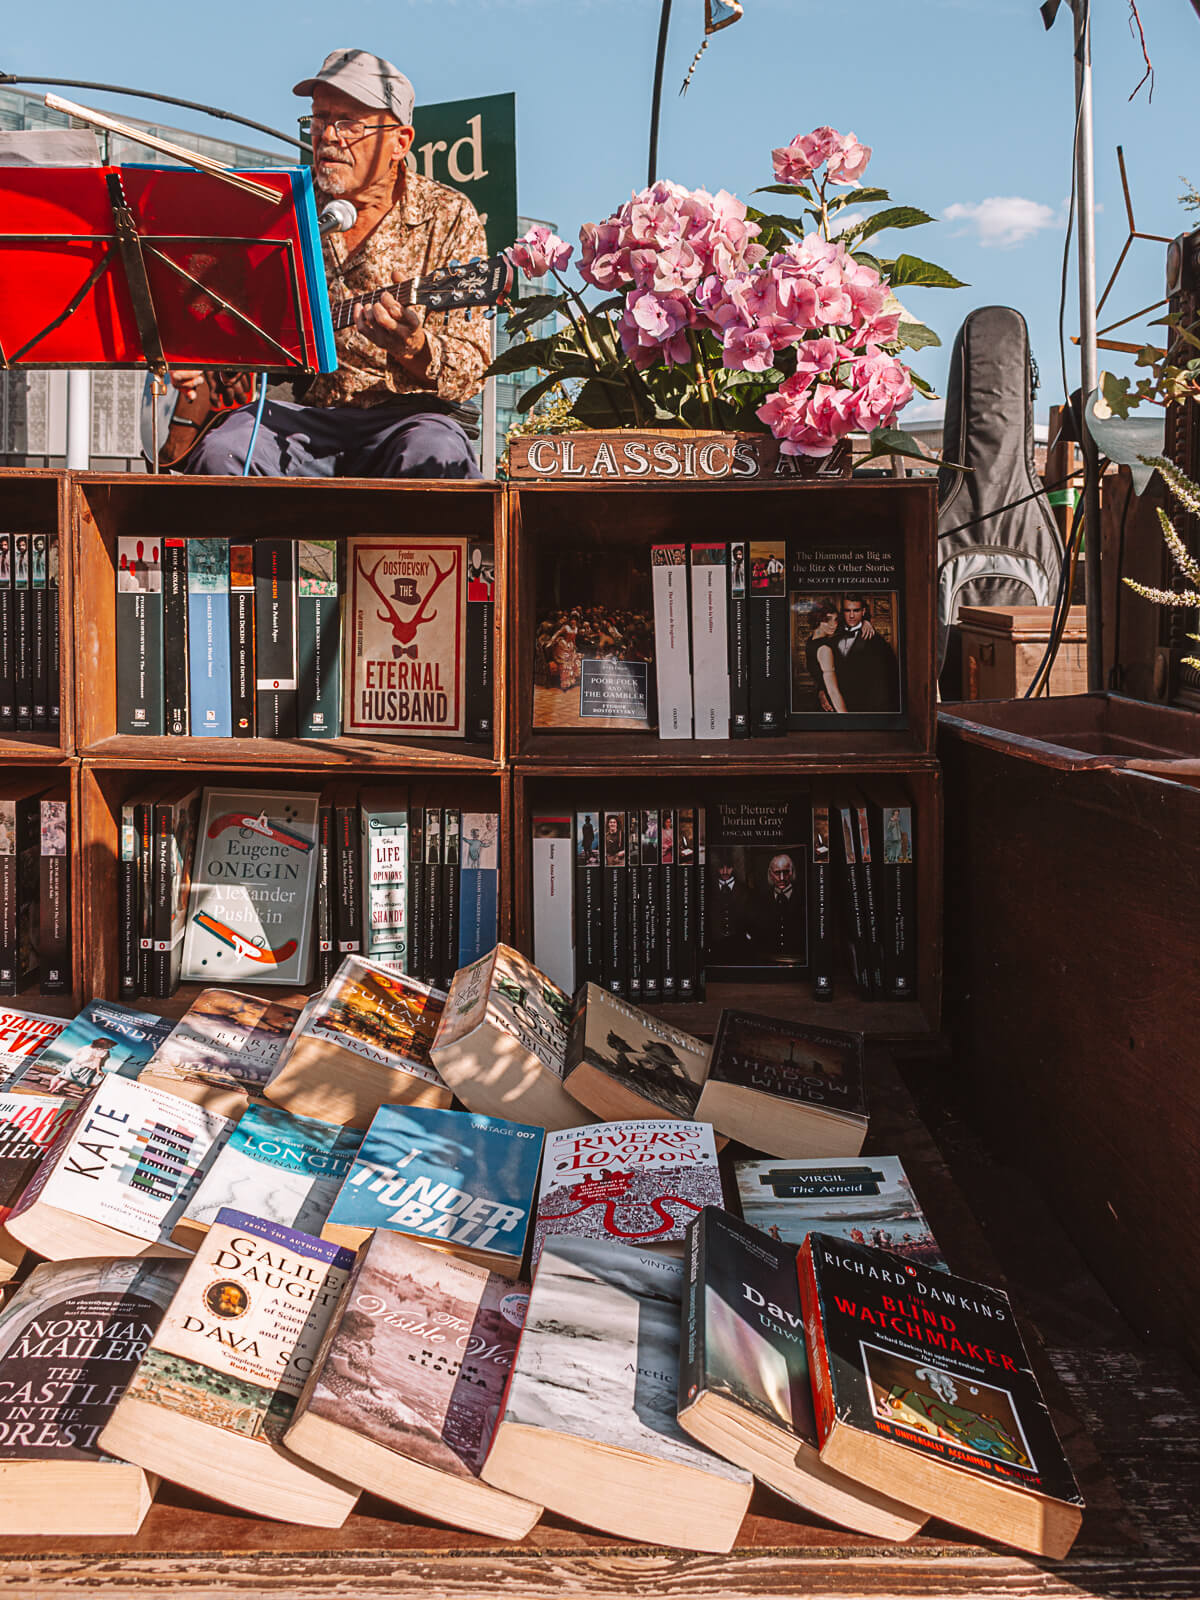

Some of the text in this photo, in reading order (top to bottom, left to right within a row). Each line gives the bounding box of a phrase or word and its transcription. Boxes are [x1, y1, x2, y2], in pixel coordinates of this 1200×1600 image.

[406, 114, 488, 183] rd
[527, 440, 760, 478] CLASSICS
[398, 550, 415, 561] Fyodor
[796, 552, 813, 560] The
[814, 552, 853, 560] Diamond
[866, 552, 880, 562] Big
[383, 561, 430, 576] DOSTOEVSKY
[792, 564, 895, 572] the Ritz & Other Stories
[400, 584, 413, 597] THE
[366, 660, 444, 691] ETERNAL
[616, 678, 638, 686] FOLK
[602, 691, 645, 700] GAMBLER
[362, 690, 448, 722] HUSBAND
[718, 804, 789, 815] The Picture of
[722, 816, 784, 828] Dorian Gray
[226, 840, 290, 860] Eugene
[376, 846, 400, 862] LIFE
[208, 860, 300, 880] ONEGIN
[373, 872, 402, 880] OPINIONS
[208, 885, 296, 902] Alexander
[213, 904, 283, 924] Pushkin
[372, 910, 404, 924] SHANDY
[0, 1014, 66, 1037] STATION
[375, 1005, 421, 1028] BOY
[175, 1033, 233, 1049] GORE
[216, 1031, 280, 1050] BURR
[310, 1027, 390, 1064] VIKRAM
[495, 1015, 552, 1065] ROBIN
[751, 1074, 825, 1101] WIND
[164, 1126, 184, 1139] the
[470, 1121, 536, 1140] VINTAGE 007
[555, 1130, 586, 1142] BEN
[593, 1124, 704, 1135] AARONOVITCH
[63, 1104, 130, 1180] KATE
[151, 1132, 189, 1155] bricks
[553, 1129, 701, 1153] RIVERS
[621, 1143, 655, 1154] OF
[145, 1157, 176, 1175] built
[155, 1148, 181, 1164] that
[242, 1148, 302, 1171] GUNNAR
[554, 1149, 698, 1172] LONDON
[141, 1170, 162, 1184] the
[800, 1174, 846, 1182] VIRGIL
[130, 1179, 172, 1201] houses
[350, 1157, 526, 1233] THUNDER
[789, 1184, 862, 1194] The Aeneid
[387, 1200, 499, 1249] BALL
[244, 1220, 338, 1258] FROM THE AUTHOR OF
[230, 1237, 346, 1291] GALILE
[824, 1252, 1006, 1322] RICHARD DAWKINS
[282, 1301, 317, 1318] Drama
[907, 1294, 926, 1306] THE
[277, 1311, 317, 1330] Science,
[356, 1294, 446, 1344] Visible
[432, 1312, 470, 1332] The
[882, 1295, 957, 1333] BLIND
[21, 1319, 154, 1341] NORMAN
[181, 1316, 262, 1358] DAVA
[274, 1322, 300, 1336] Faith
[758, 1312, 804, 1346] Unw
[834, 1296, 1018, 1374] WATCHMAKER
[8, 1337, 148, 1361] MAILER
[258, 1329, 308, 1350] and Love
[898, 1340, 923, 1354] Dawkins
[407, 1354, 488, 1389] SLOUKA
[421, 1350, 479, 1375] MARK
[47, 1367, 89, 1381] THE
[624, 1363, 674, 1383] Arctic
[0, 1380, 128, 1406] CASTLE
[6, 1406, 83, 1421] IN THE
[874, 1420, 892, 1434] THE
[895, 1426, 945, 1454] UNIVERSALLY
[948, 1448, 992, 1470] ACCLAIMED
